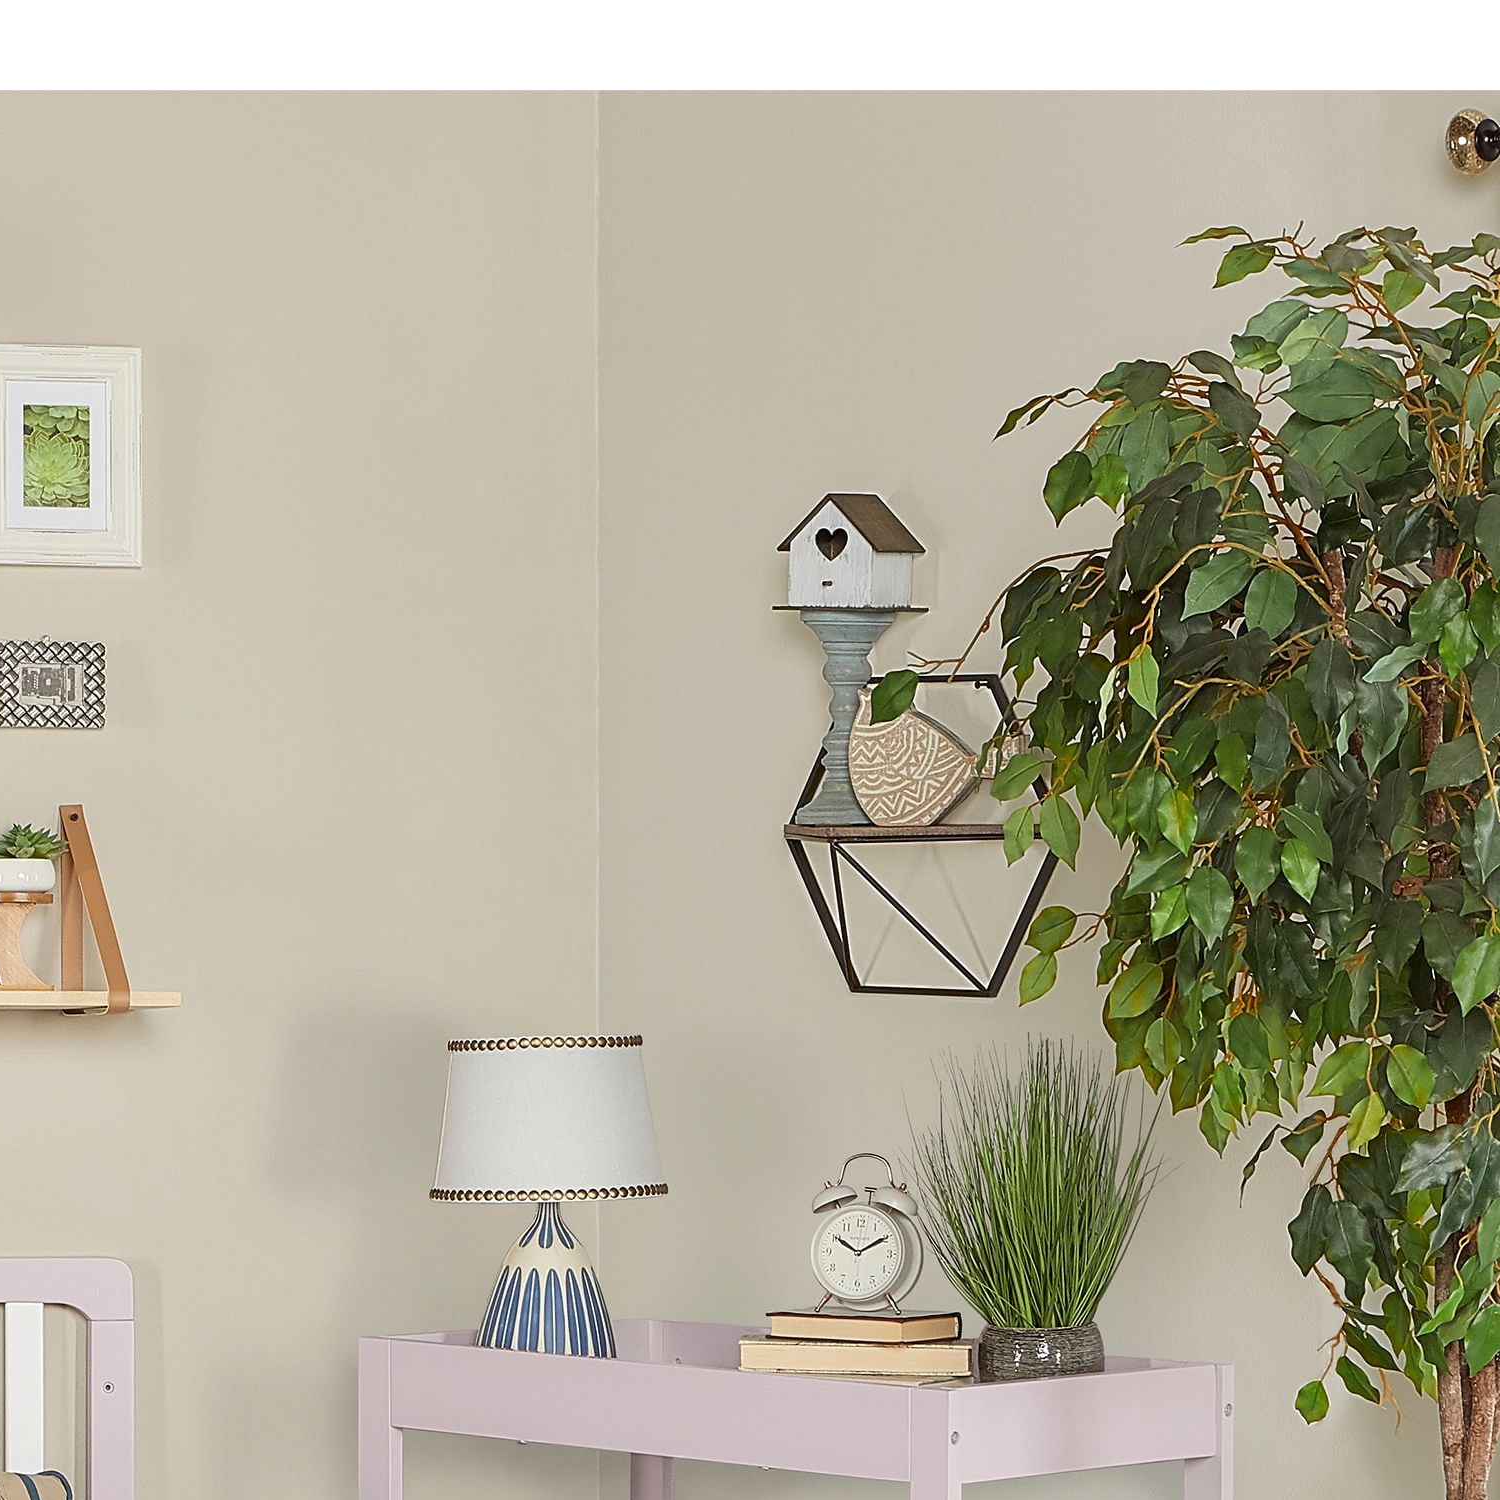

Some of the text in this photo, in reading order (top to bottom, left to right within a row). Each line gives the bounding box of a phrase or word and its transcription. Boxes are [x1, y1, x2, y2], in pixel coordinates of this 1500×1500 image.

[842, 1222, 850, 1232] 11
[856, 1218, 866, 1228] 12
[825, 1247, 832, 1255] 9
[886, 1249, 893, 1258] 3
[829, 1263, 836, 1272] 8
[854, 1279, 861, 1288] 6
[869, 1275, 876, 1284] 5
